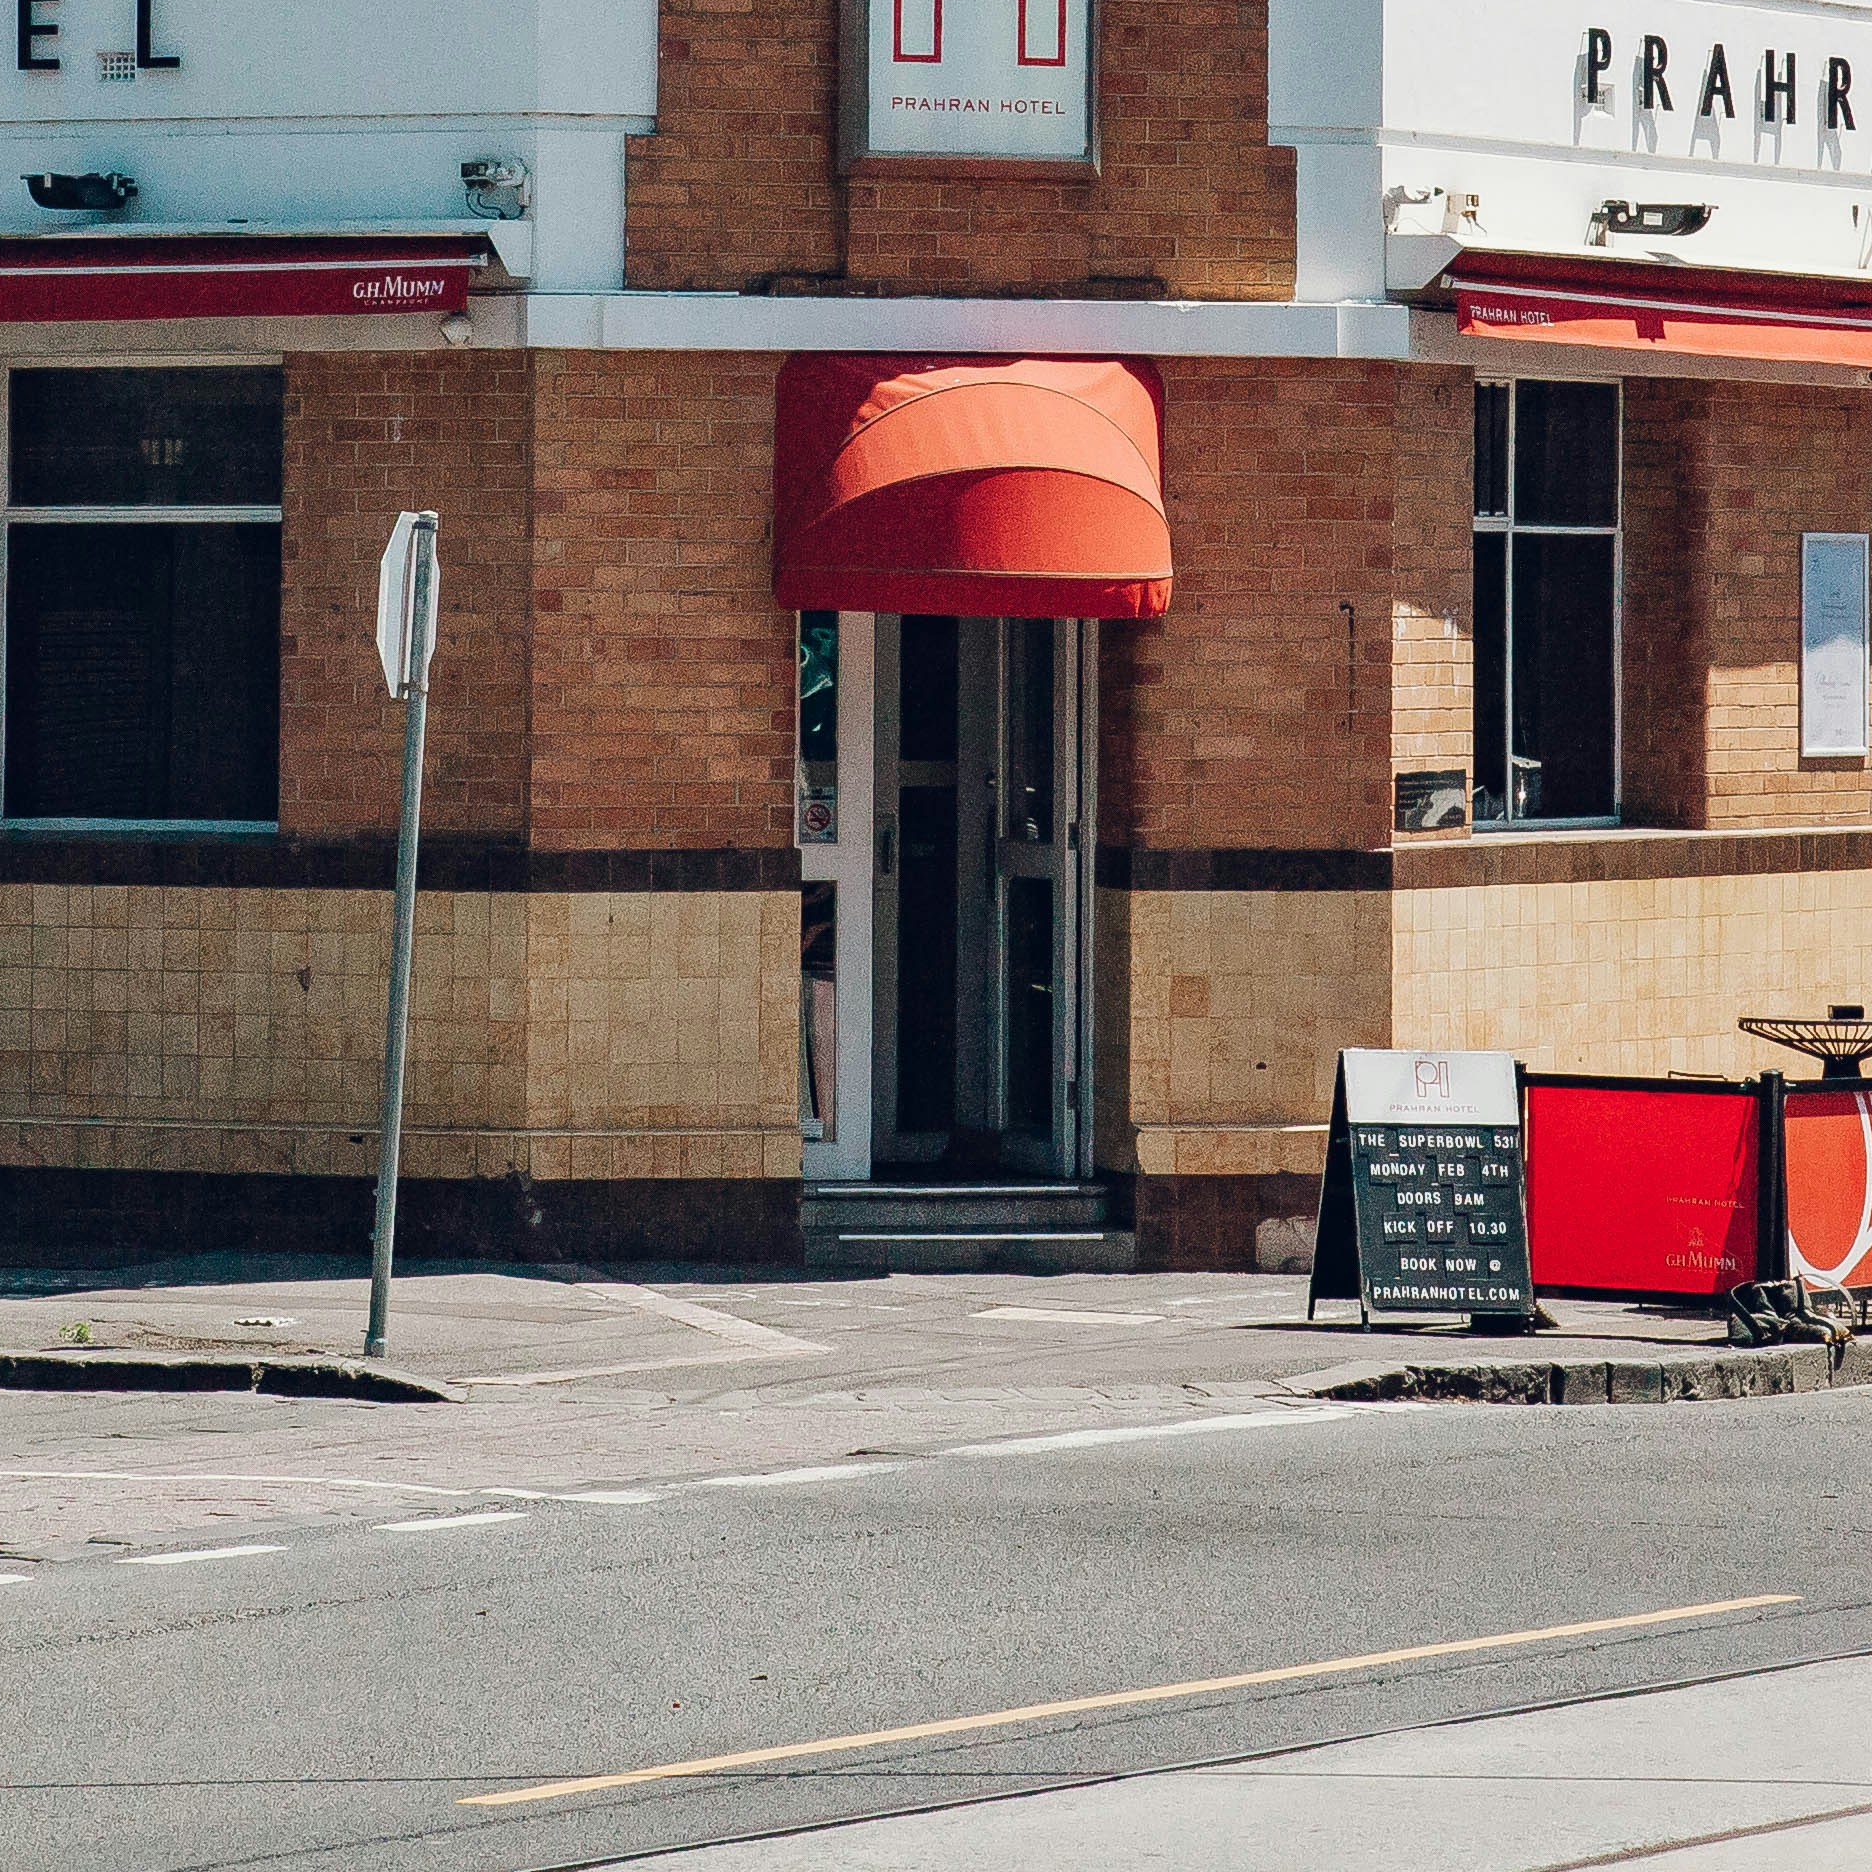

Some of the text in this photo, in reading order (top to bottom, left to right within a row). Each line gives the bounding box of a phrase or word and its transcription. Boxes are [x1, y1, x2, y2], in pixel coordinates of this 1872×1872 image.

[891, 96, 1066, 115] PRAHRAN HOTEL
[1470, 305, 1555, 326] PRAHRAN HOTEL
[1389, 1103, 1481, 1114] PRAHRAN HOTEL
[1358, 1133, 1386, 1147] THE
[1399, 1134, 1484, 1149] SUPERBOWL
[1370, 1163, 1509, 1178] MONDAY FEB 4TH
[1397, 1191, 1485, 1206] DOORS 9AM
[1666, 1195, 1745, 1209] PRAHRAN HOTEL
[1383, 1220, 1508, 1236] KICK OFF 10.30
[1400, 1257, 1502, 1272] BOOK NOW @
[1373, 1285, 1521, 1301] PRAHRANHOTEL.COM
